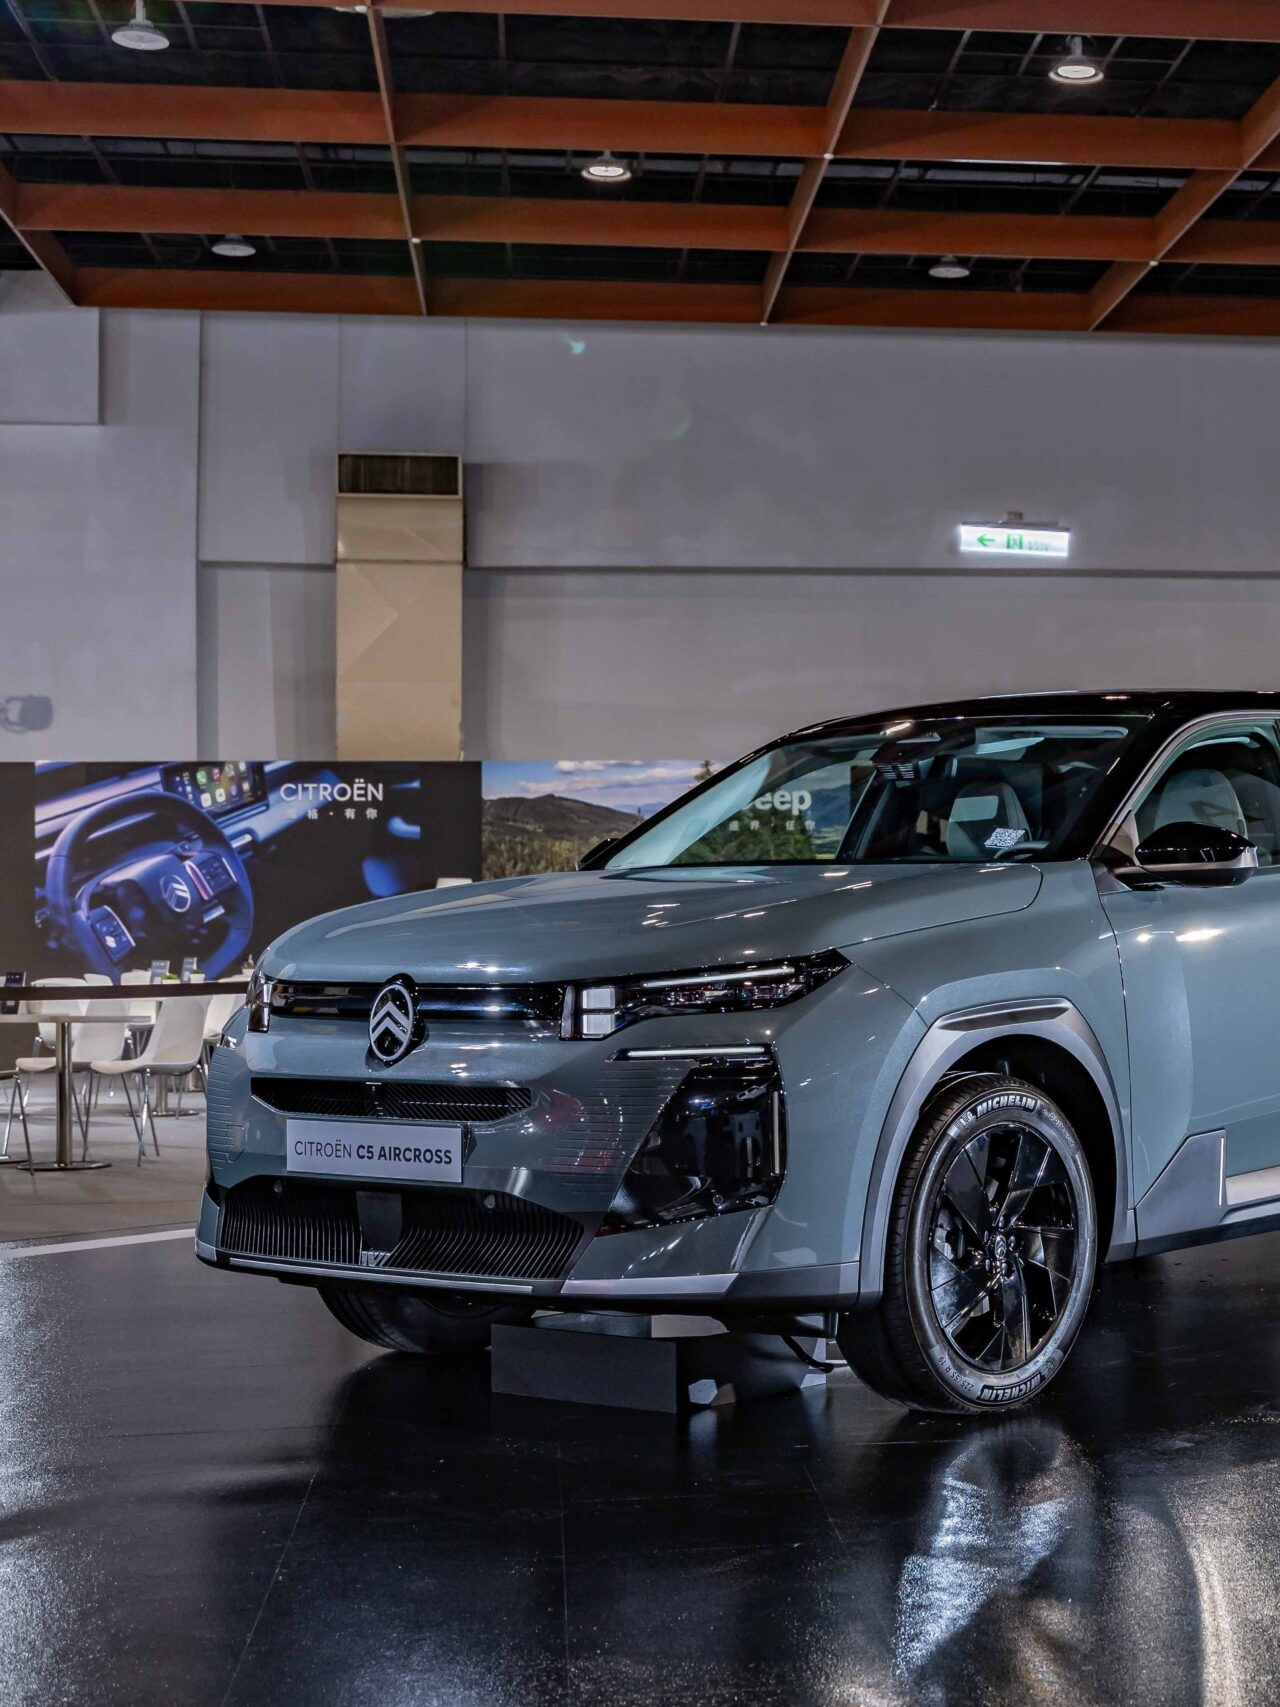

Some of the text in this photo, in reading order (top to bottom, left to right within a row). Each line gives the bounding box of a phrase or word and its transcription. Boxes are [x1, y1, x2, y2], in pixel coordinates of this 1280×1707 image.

[280, 778, 384, 802] CITROËN
[743, 790, 812, 816] eep
[976, 1095, 1036, 1118] MICHELIN
[294, 1139, 452, 1165] CITROËN C5 AIRCROSS
[950, 1371, 975, 1392] 225/55
[980, 1372, 1041, 1401] MICHELIN
